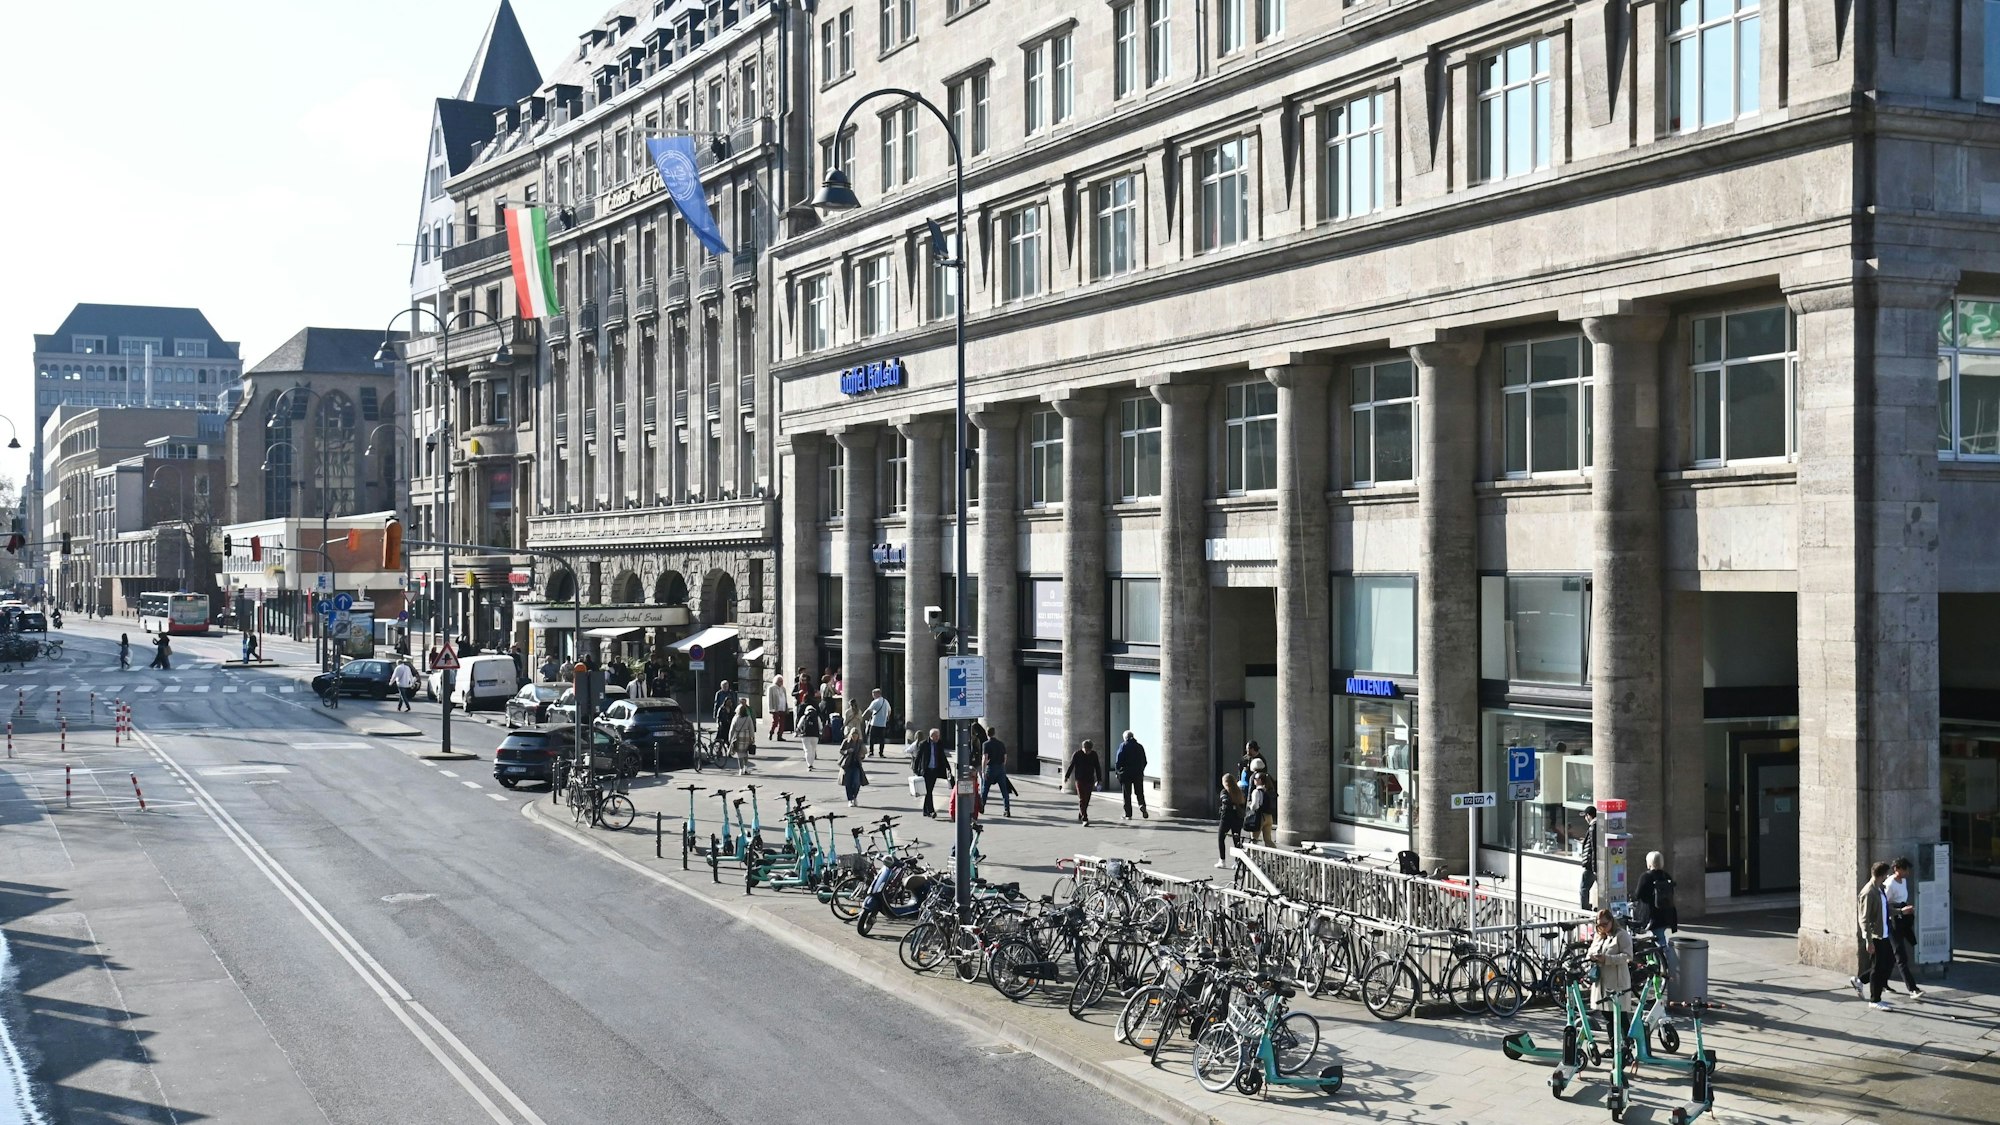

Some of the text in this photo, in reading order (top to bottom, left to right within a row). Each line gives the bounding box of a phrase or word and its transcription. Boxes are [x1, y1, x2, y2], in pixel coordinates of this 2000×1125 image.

[581, 611, 663, 622] Excelsior Hotel Ernst
[1346, 678, 1392, 696] MILLENIA
[1514, 752, 1530, 778] P
